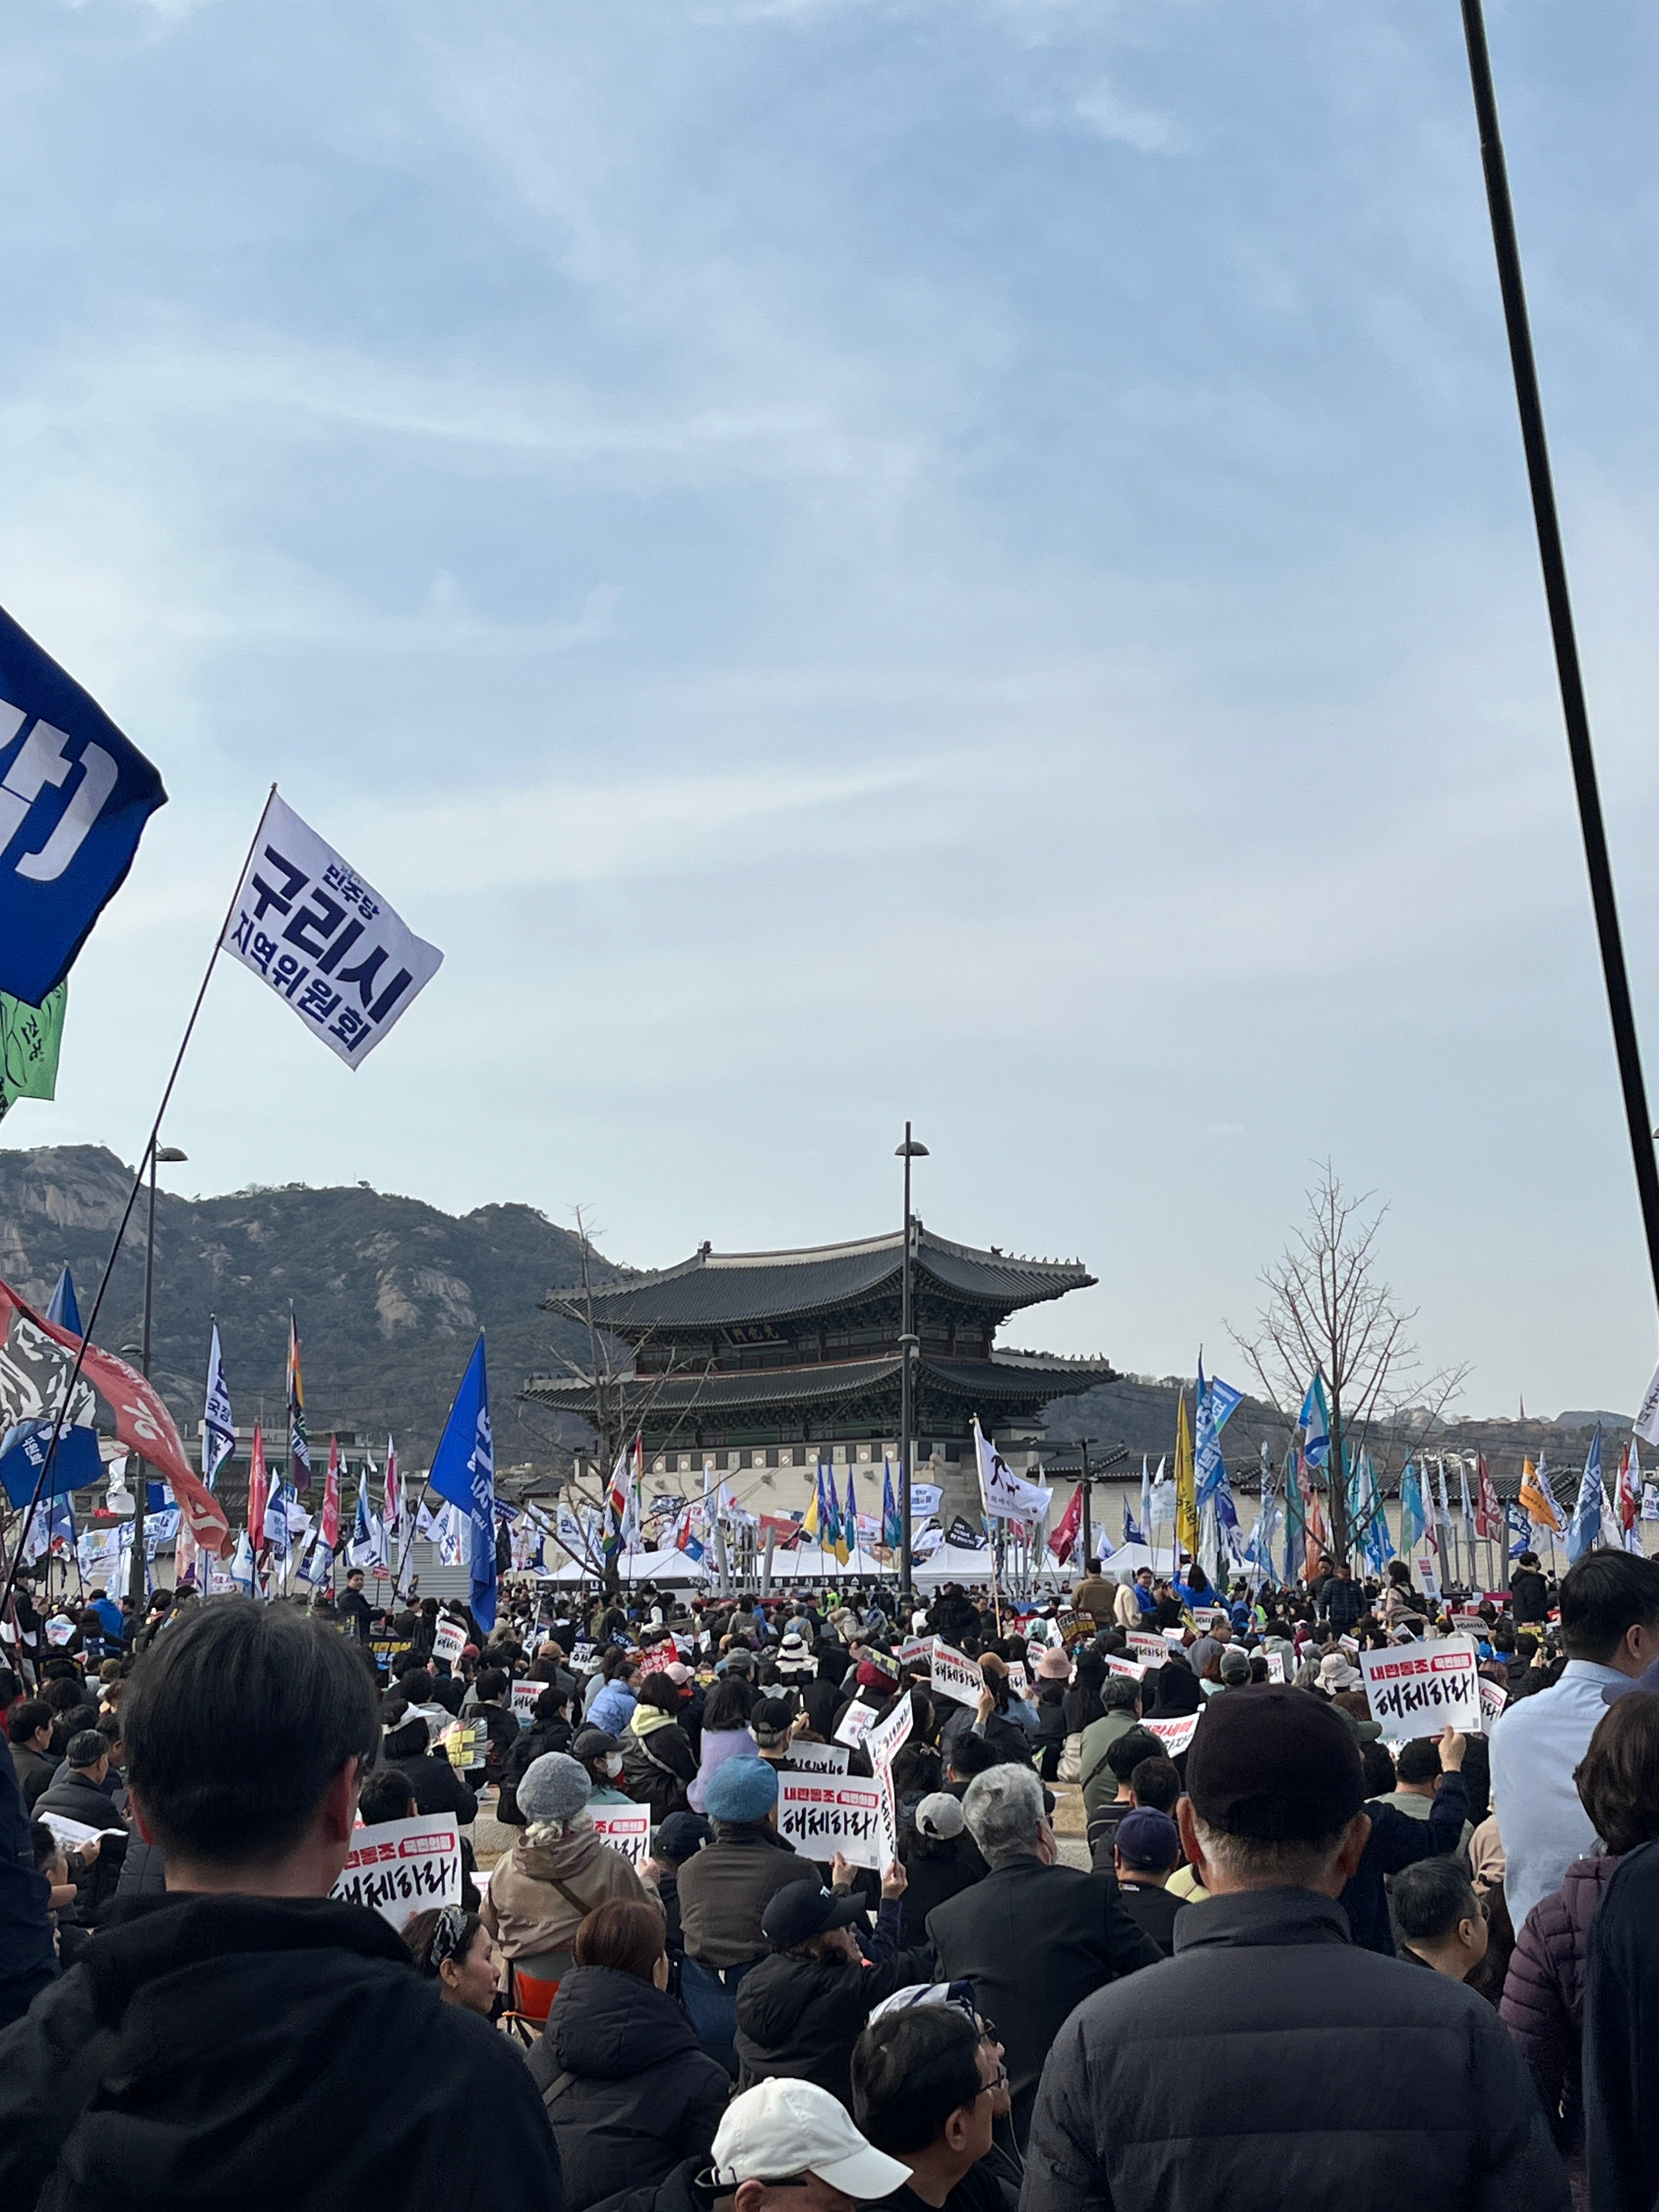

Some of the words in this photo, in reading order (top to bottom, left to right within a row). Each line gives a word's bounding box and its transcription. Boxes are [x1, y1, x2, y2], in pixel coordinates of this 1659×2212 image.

[323, 864, 380, 921] 민주당
[251, 844, 413, 1024] 구리시
[231, 910, 371, 1052] 지역위원회
[1369, 1658, 1429, 1681] 내란동조
[1374, 1672, 1475, 1719] 해체하라!
[784, 1787, 835, 1804] 내란동조
[782, 1807, 878, 1839] 해체하라!
[344, 1841, 397, 1870] 란동조
